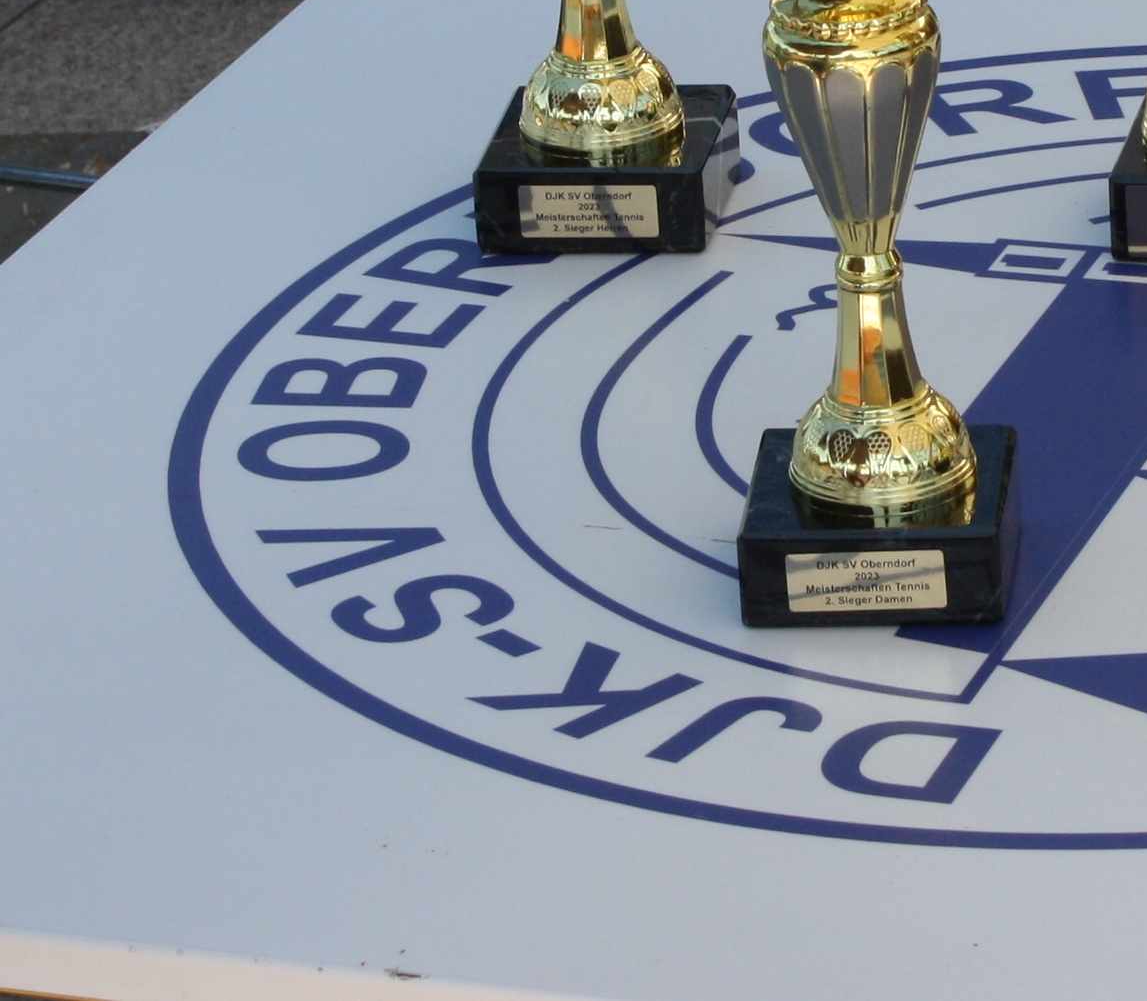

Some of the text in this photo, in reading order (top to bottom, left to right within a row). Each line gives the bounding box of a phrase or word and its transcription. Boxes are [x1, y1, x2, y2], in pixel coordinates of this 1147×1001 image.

[545, 191, 632, 200] DJK SV Oberndorf
[578, 203, 601, 211] 2023
[536, 213, 644, 222] Meisterschaften Tennis
[564, 224, 594, 233] Sieger
[817, 558, 915, 570] DJK SV Oberndorf
[855, 573, 880, 582] 2023
[806, 582, 930, 594] Meisterschaften Tennis
[838, 596, 871, 606] Sieger
[875, 595, 913, 604] Damen
